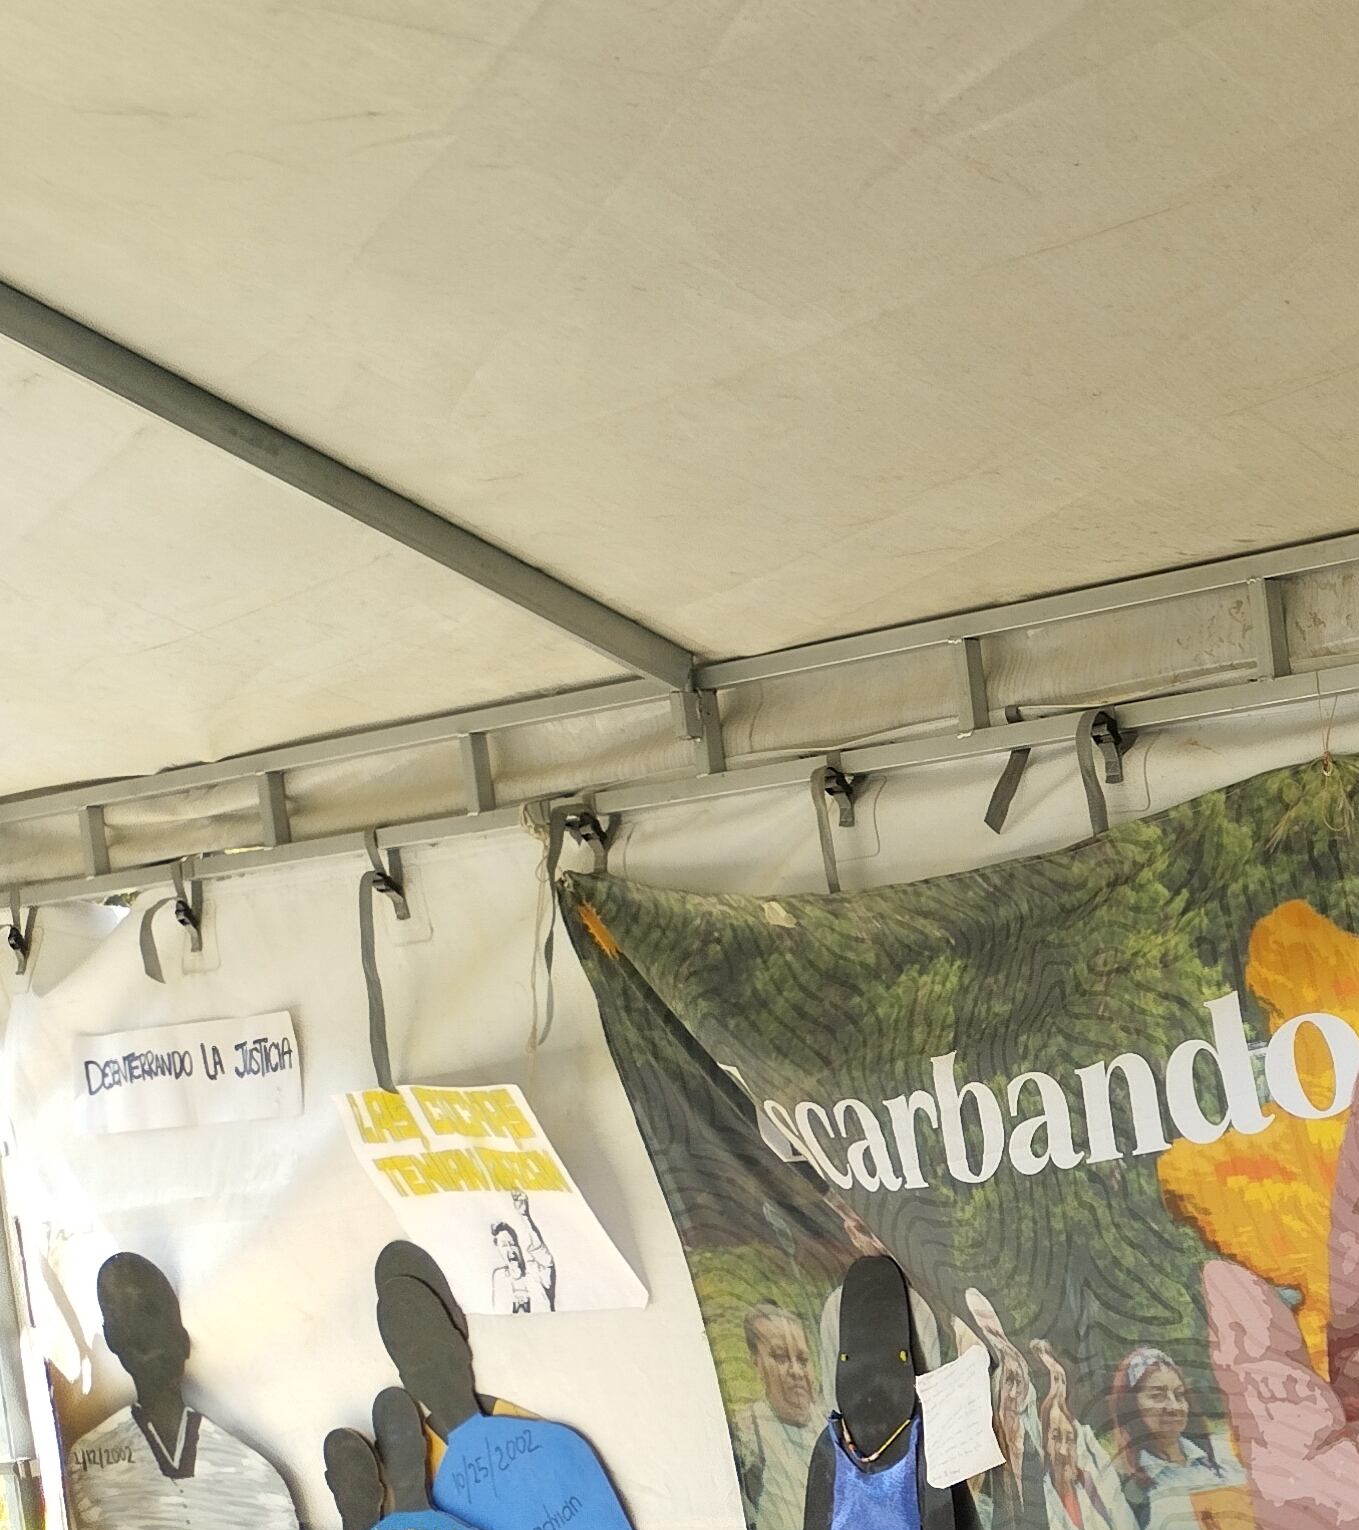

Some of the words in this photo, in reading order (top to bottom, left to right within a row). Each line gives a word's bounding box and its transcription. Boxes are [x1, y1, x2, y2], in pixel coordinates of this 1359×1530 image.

[200, 1042, 226, 1081] LA
[233, 1037, 294, 1079] JUSTICIA
[345, 1090, 424, 1145] LAS
